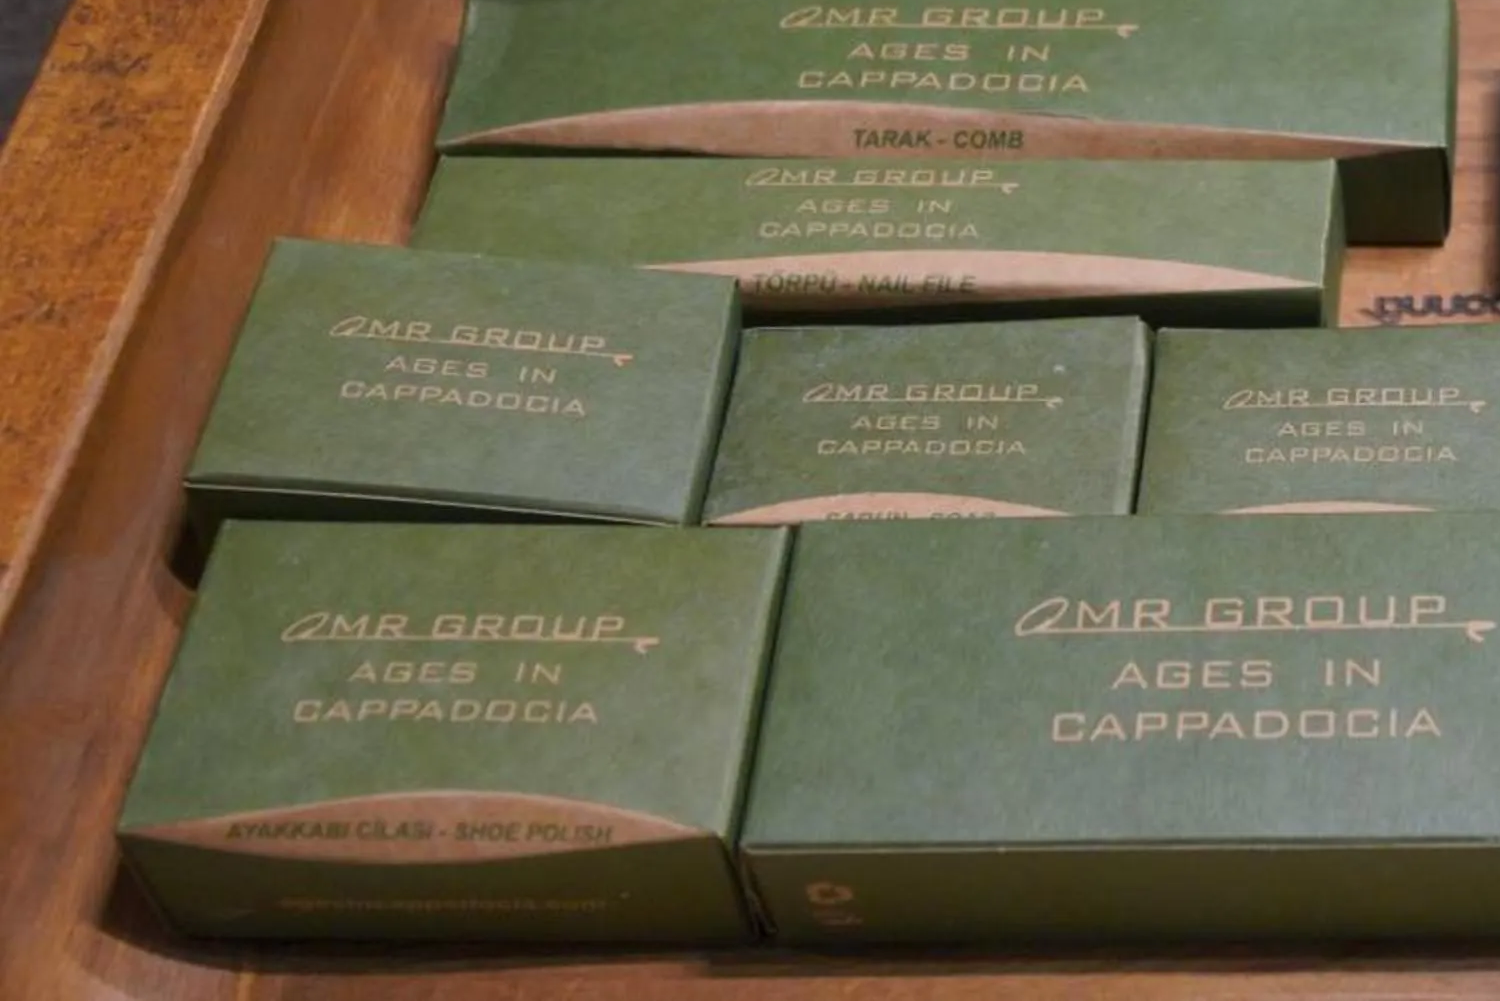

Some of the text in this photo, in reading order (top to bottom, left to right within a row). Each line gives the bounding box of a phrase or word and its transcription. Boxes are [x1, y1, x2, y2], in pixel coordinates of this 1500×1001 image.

[922, 7, 1106, 29] GROUP
[846, 42, 1051, 62] AGES IN
[797, 69, 1090, 94] CAPPADOCIA
[853, 129, 930, 148] TARAK
[953, 130, 1024, 148] COMB
[853, 169, 994, 186] GROUP
[796, 198, 951, 214] AGES IN
[759, 222, 979, 239] CAPPADOCIA
[921, 276, 977, 293] FILE
[451, 325, 607, 353] GROUP
[386, 356, 557, 383] AGES IN
[341, 381, 586, 416] CAPPADOCIA
[905, 384, 1040, 401] GROUP
[1327, 387, 1460, 405] GROUP
[851, 416, 998, 430] AGES IN
[1277, 420, 1424, 437] AGES IN
[818, 440, 1026, 455] CAPPADOCIA
[1245, 446, 1457, 463] CAPPADOCIA
[1206, 595, 1446, 630] GROUP
[432, 614, 625, 641] GROUP
[349, 661, 563, 684] AGES IN
[1111, 659, 1381, 690] AGES IN
[294, 699, 598, 724] CAPPADOCIA
[1052, 707, 1442, 742] CAPPADOCIA
[454, 822, 520, 842] SHOE
[526, 824, 613, 844] POLISH
